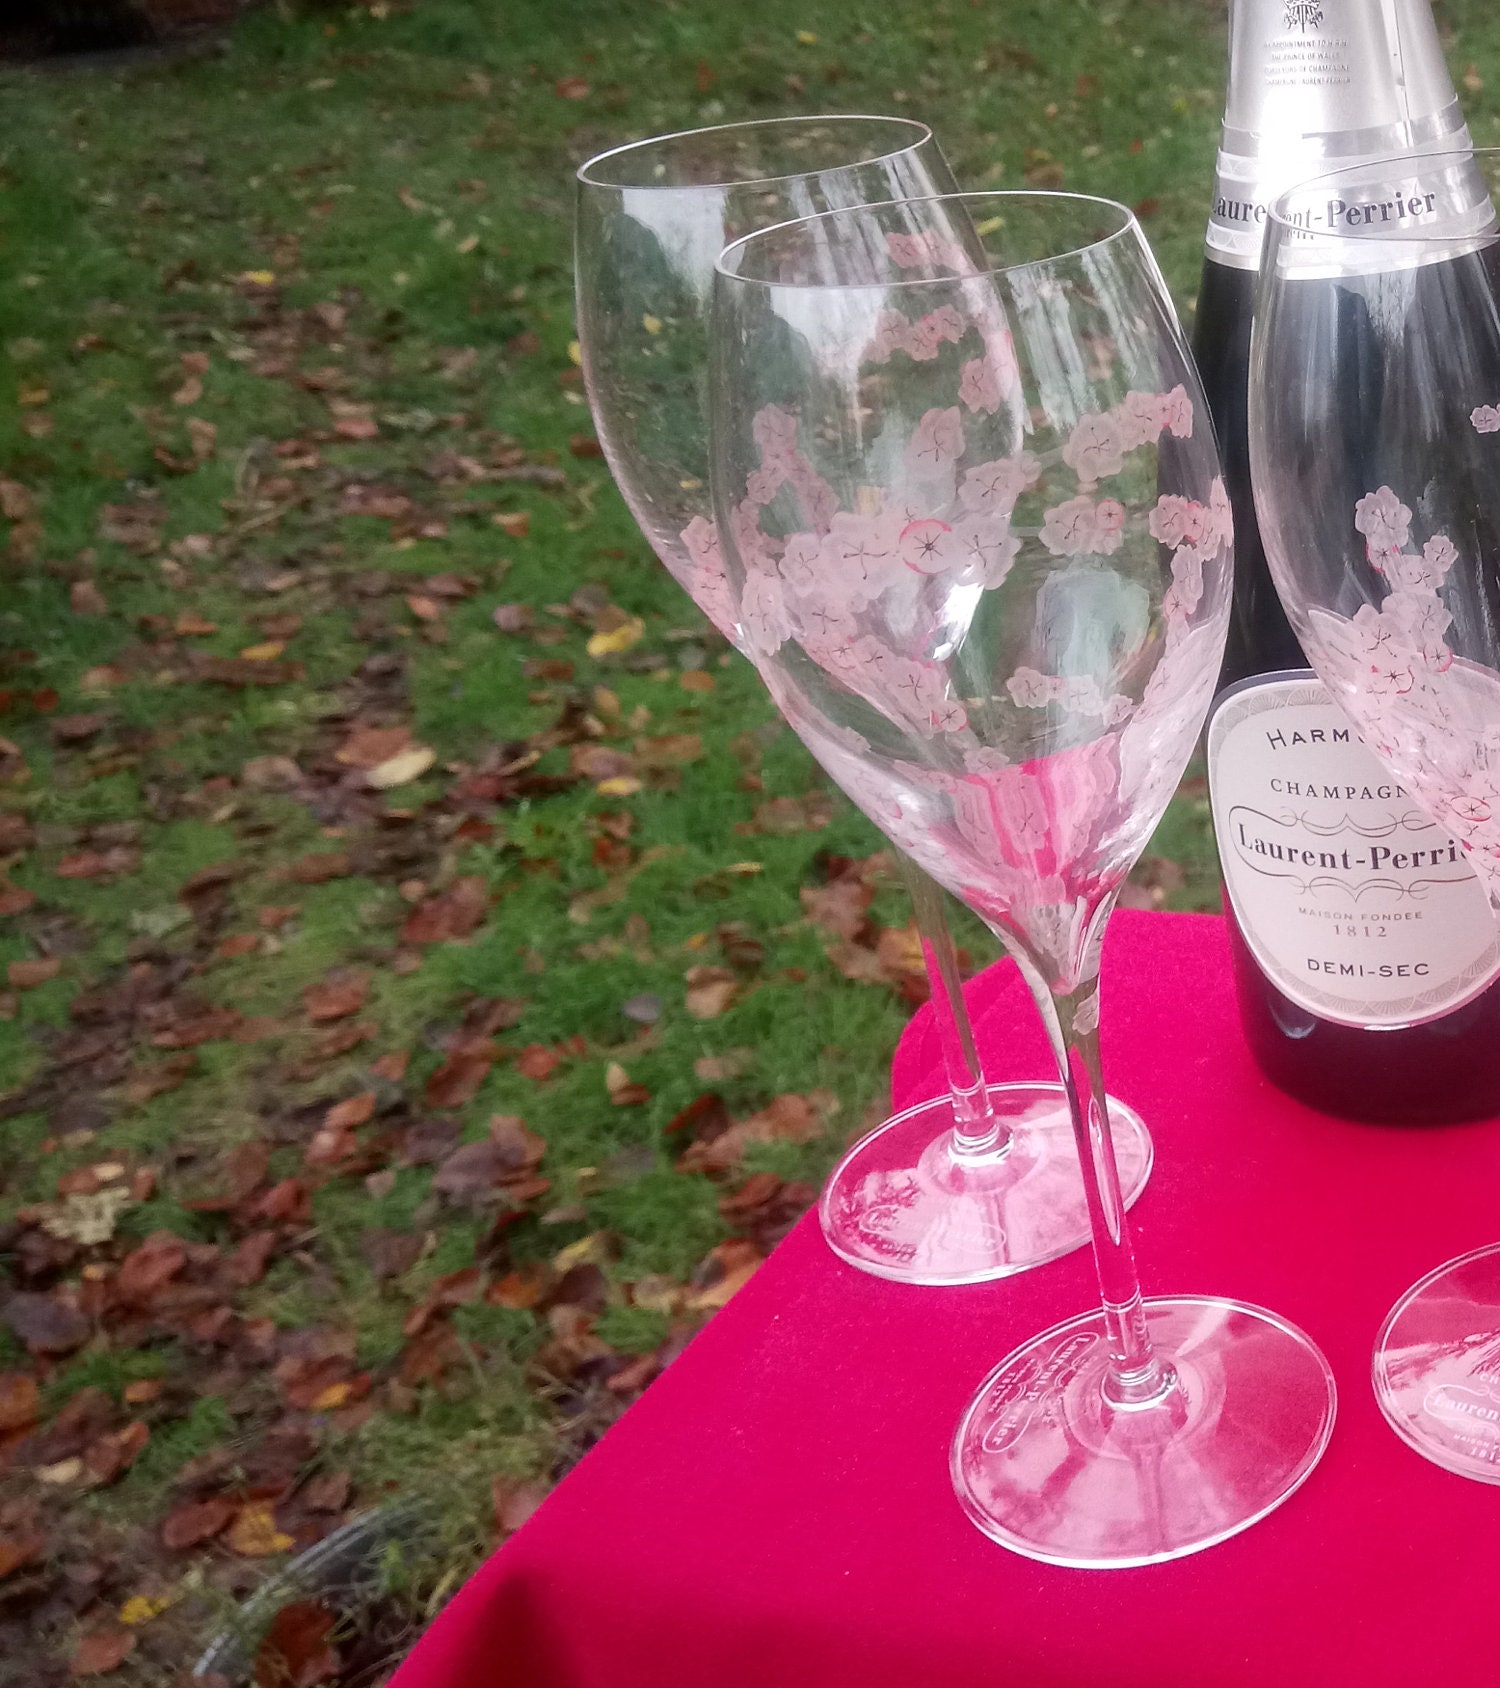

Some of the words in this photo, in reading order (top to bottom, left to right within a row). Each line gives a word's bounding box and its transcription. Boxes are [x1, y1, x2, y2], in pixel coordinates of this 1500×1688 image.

[1212, 191, 1435, 229] aurent-Perrier
[1266, 728, 1365, 750] HARM
[1238, 823, 1467, 871] Laurent-Perri
[1298, 907, 1353, 921] MAISON
[1334, 924, 1388, 938] 1812
[1307, 958, 1430, 978] DEMI-SEC
